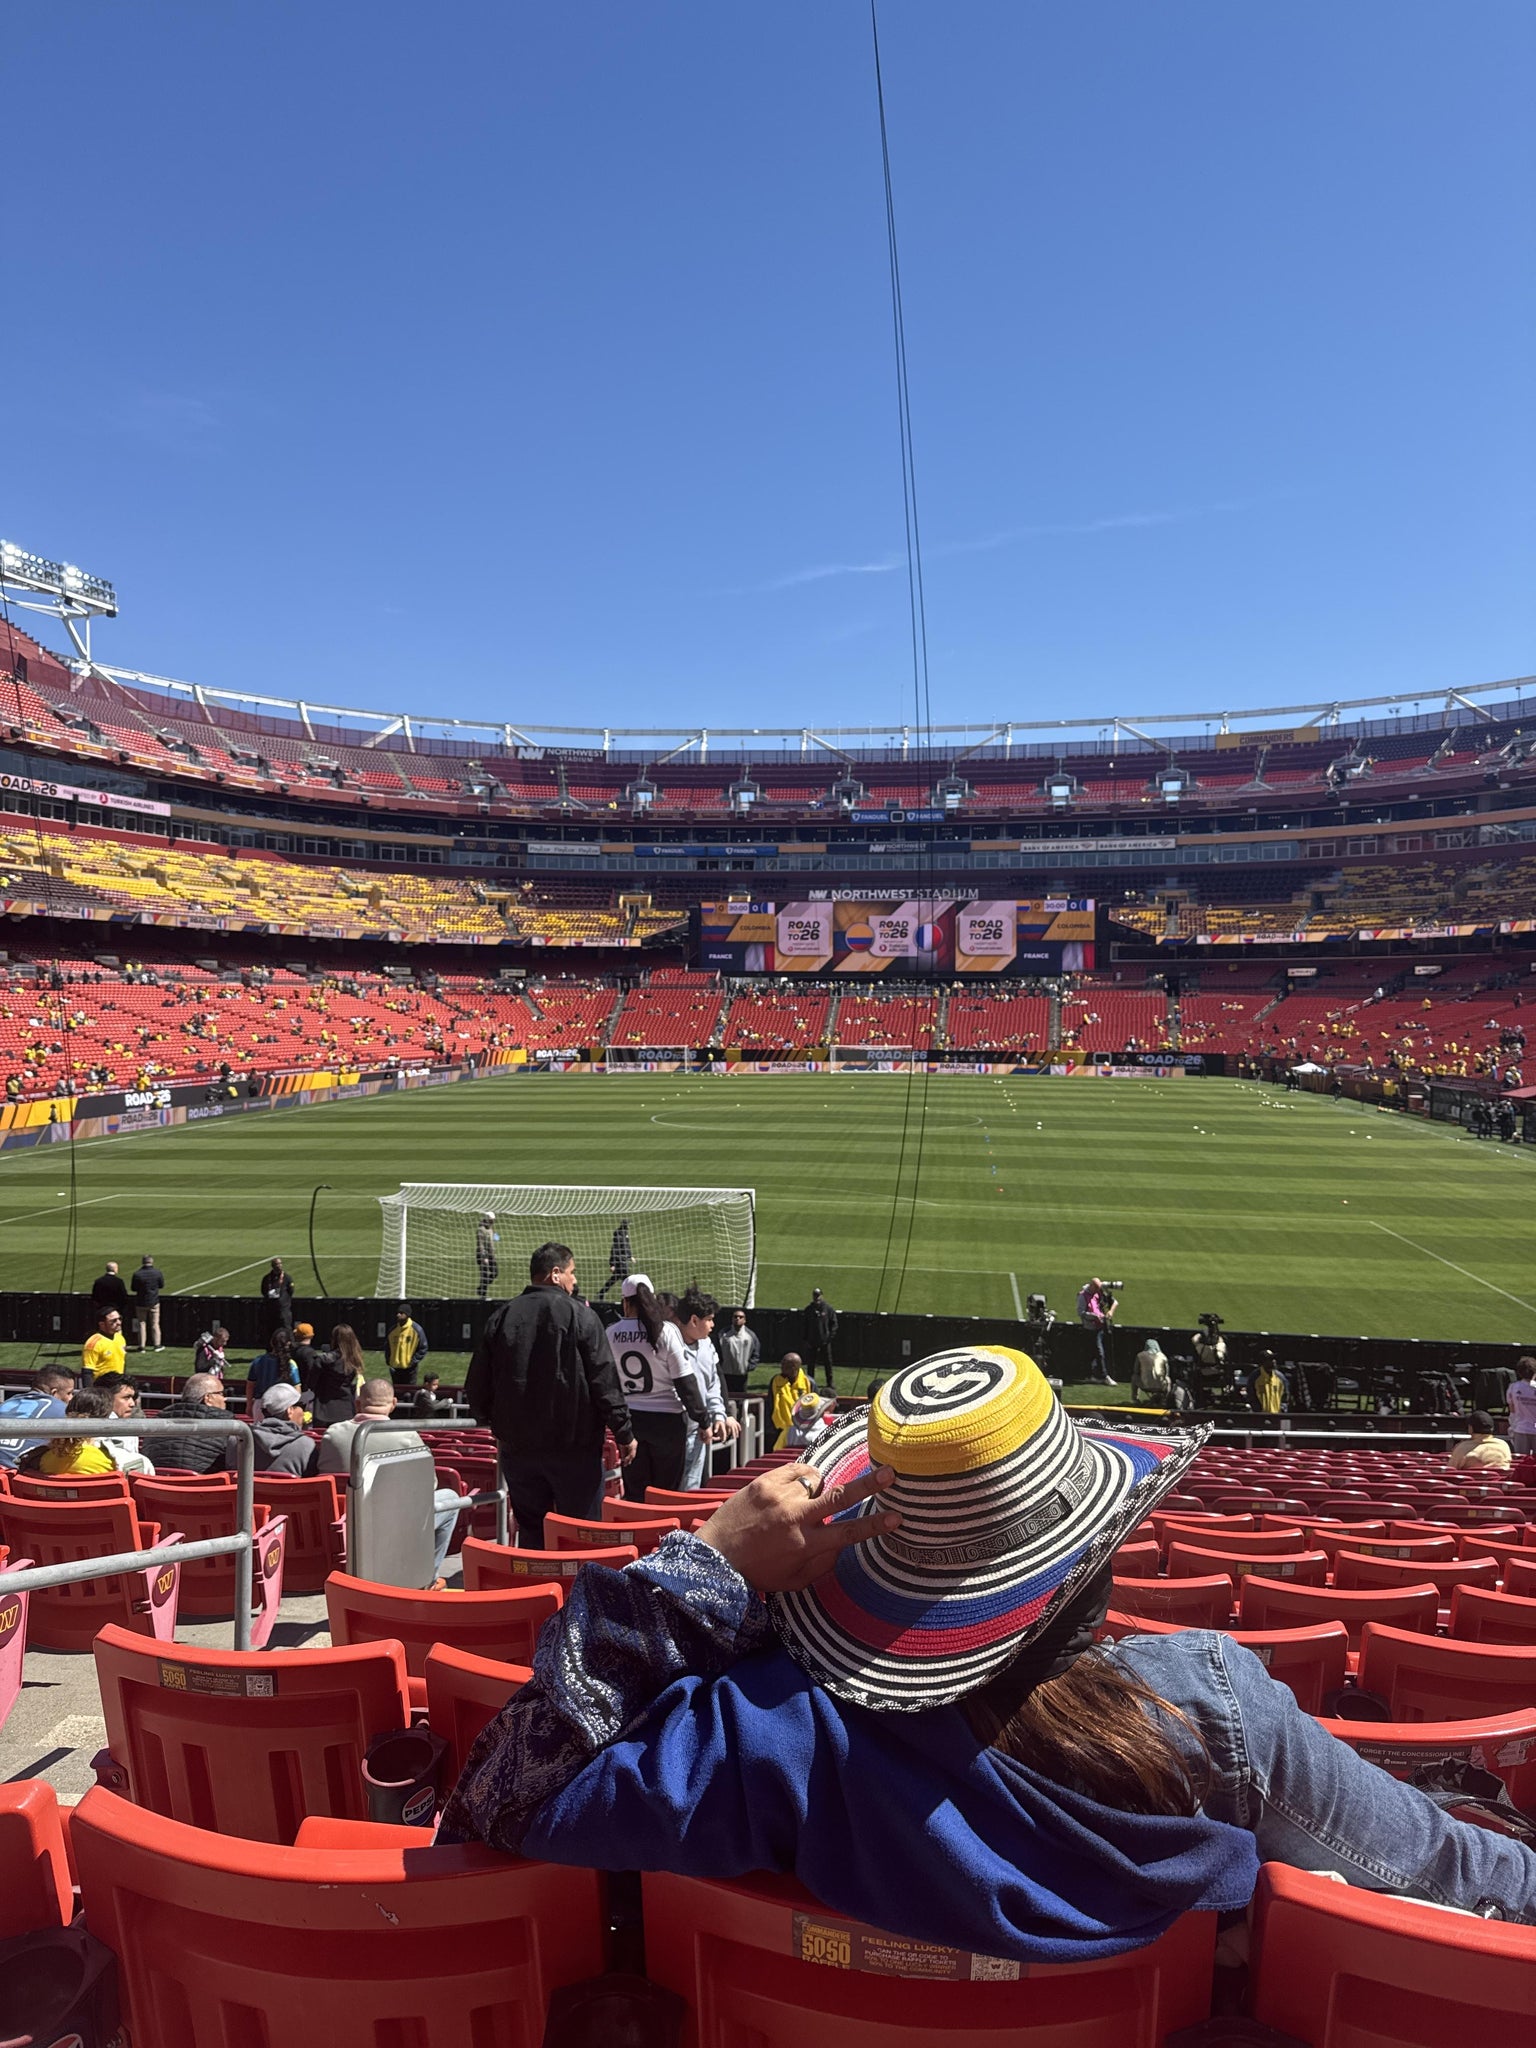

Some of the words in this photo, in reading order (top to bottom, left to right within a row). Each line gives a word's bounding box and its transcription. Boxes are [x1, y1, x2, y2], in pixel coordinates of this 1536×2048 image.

[547, 748, 604, 757] NORTHWEST
[0, 774, 30, 791] OAD
[41, 783, 58, 796] 26
[832, 889, 913, 899] NORTHWEST
[917, 888, 979, 899] STADIUM
[788, 921, 820, 929] ROAD
[969, 920, 1003, 928] ROAD
[800, 930, 820, 940] 26
[890, 929, 908, 938] 26
[982, 929, 1003, 940] 26
[638, 1051, 672, 1060] ROAD
[867, 1051, 902, 1060] ROAD
[912, 1051, 928, 1060] 26
[1184, 1055, 1201, 1064] 26
[125, 1092, 154, 1107] ROAD
[188, 1106, 208, 1119] ROAD
[122, 1113, 143, 1124] ROAD
[613, 1332, 648, 1343] MBAPP
[620, 1350, 653, 1396] 9
[1359, 1748, 1386, 1756] FORGET
[861, 1936, 910, 1950] FEELING
[914, 1944, 960, 1954] LUCKY?
[864, 1950, 900, 1960] PURCHASE
